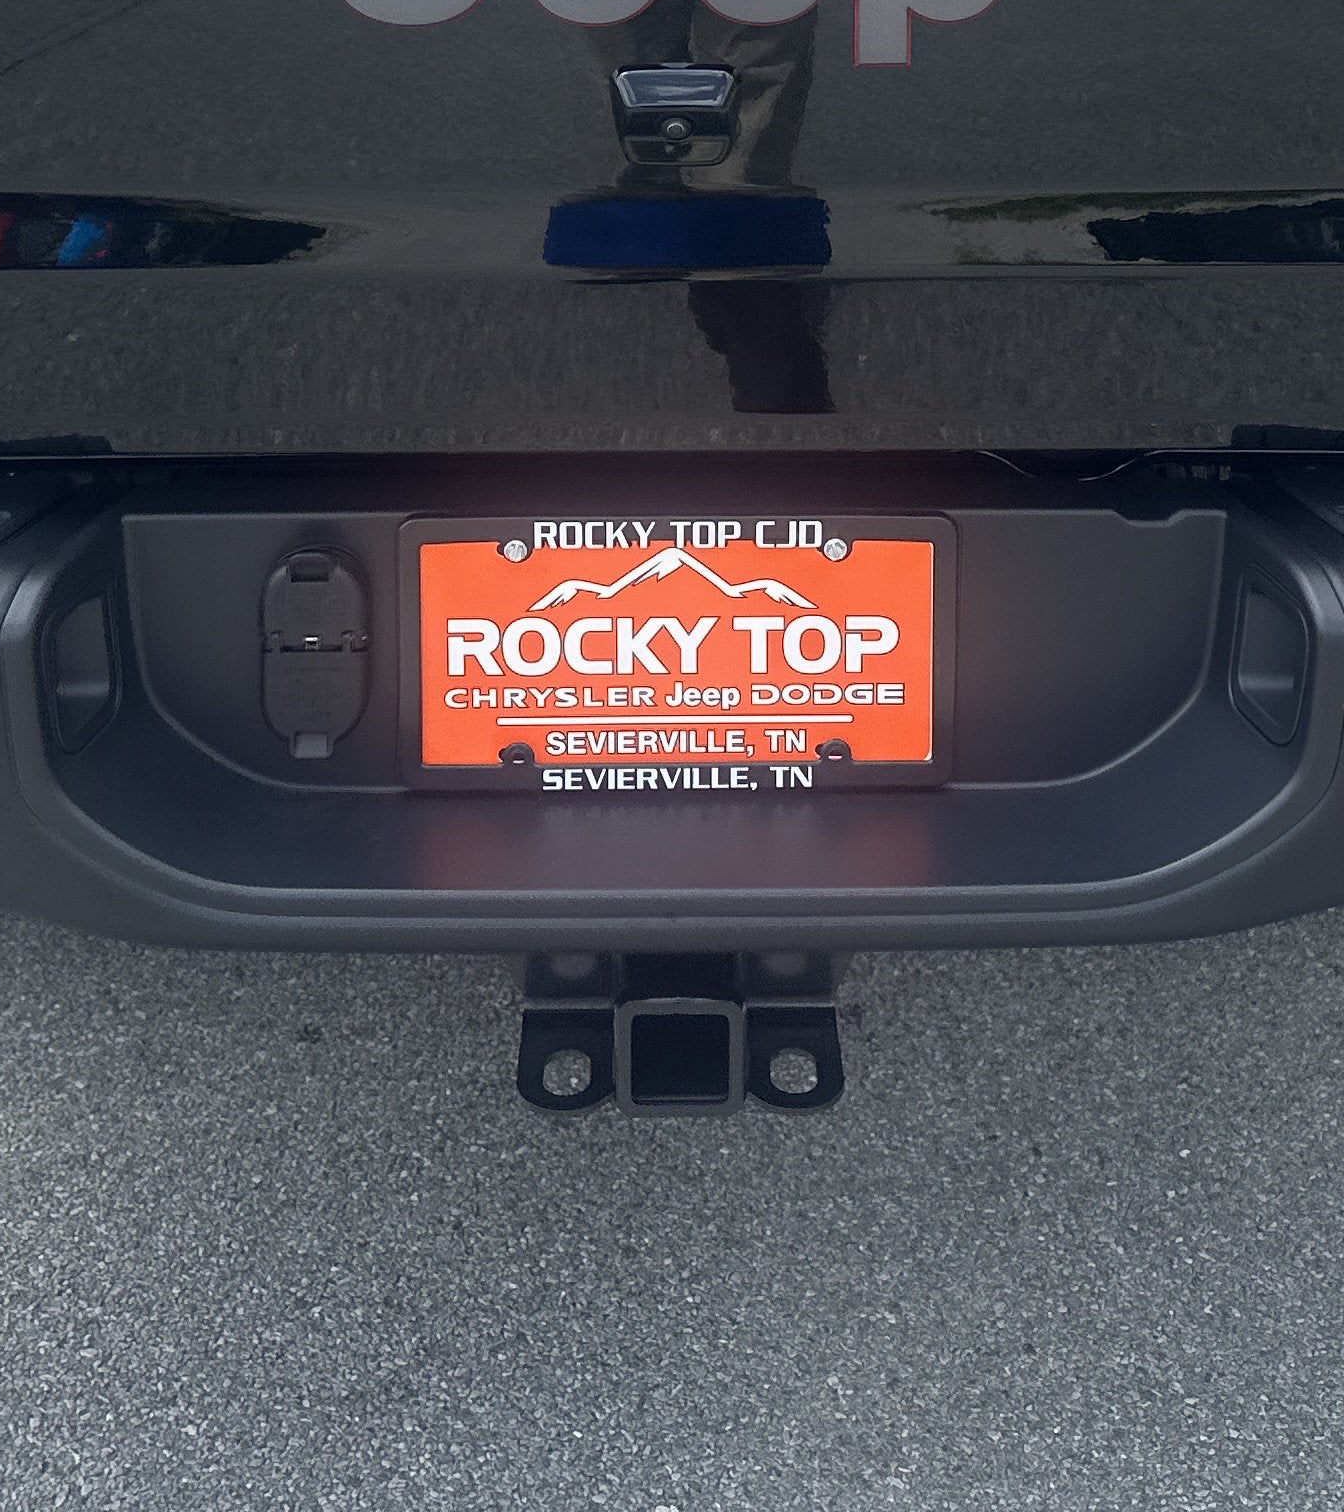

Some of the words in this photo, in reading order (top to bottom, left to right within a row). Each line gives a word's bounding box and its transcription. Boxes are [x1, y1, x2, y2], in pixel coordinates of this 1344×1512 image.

[533, 521, 656, 550] ROCKY
[669, 521, 742, 550] TOP
[755, 520, 823, 549] CJD
[446, 616, 720, 677] ROCKY
[732, 614, 900, 675] TOP
[444, 686, 655, 710] CHRYSLER
[665, 681, 741, 711] Jeep
[751, 682, 905, 706] DODGE
[545, 729, 755, 757] SEVIERVILLE,
[764, 729, 807, 753] TN
[542, 766, 758, 791] SEVIERVILLE,
[769, 765, 813, 789] TN
